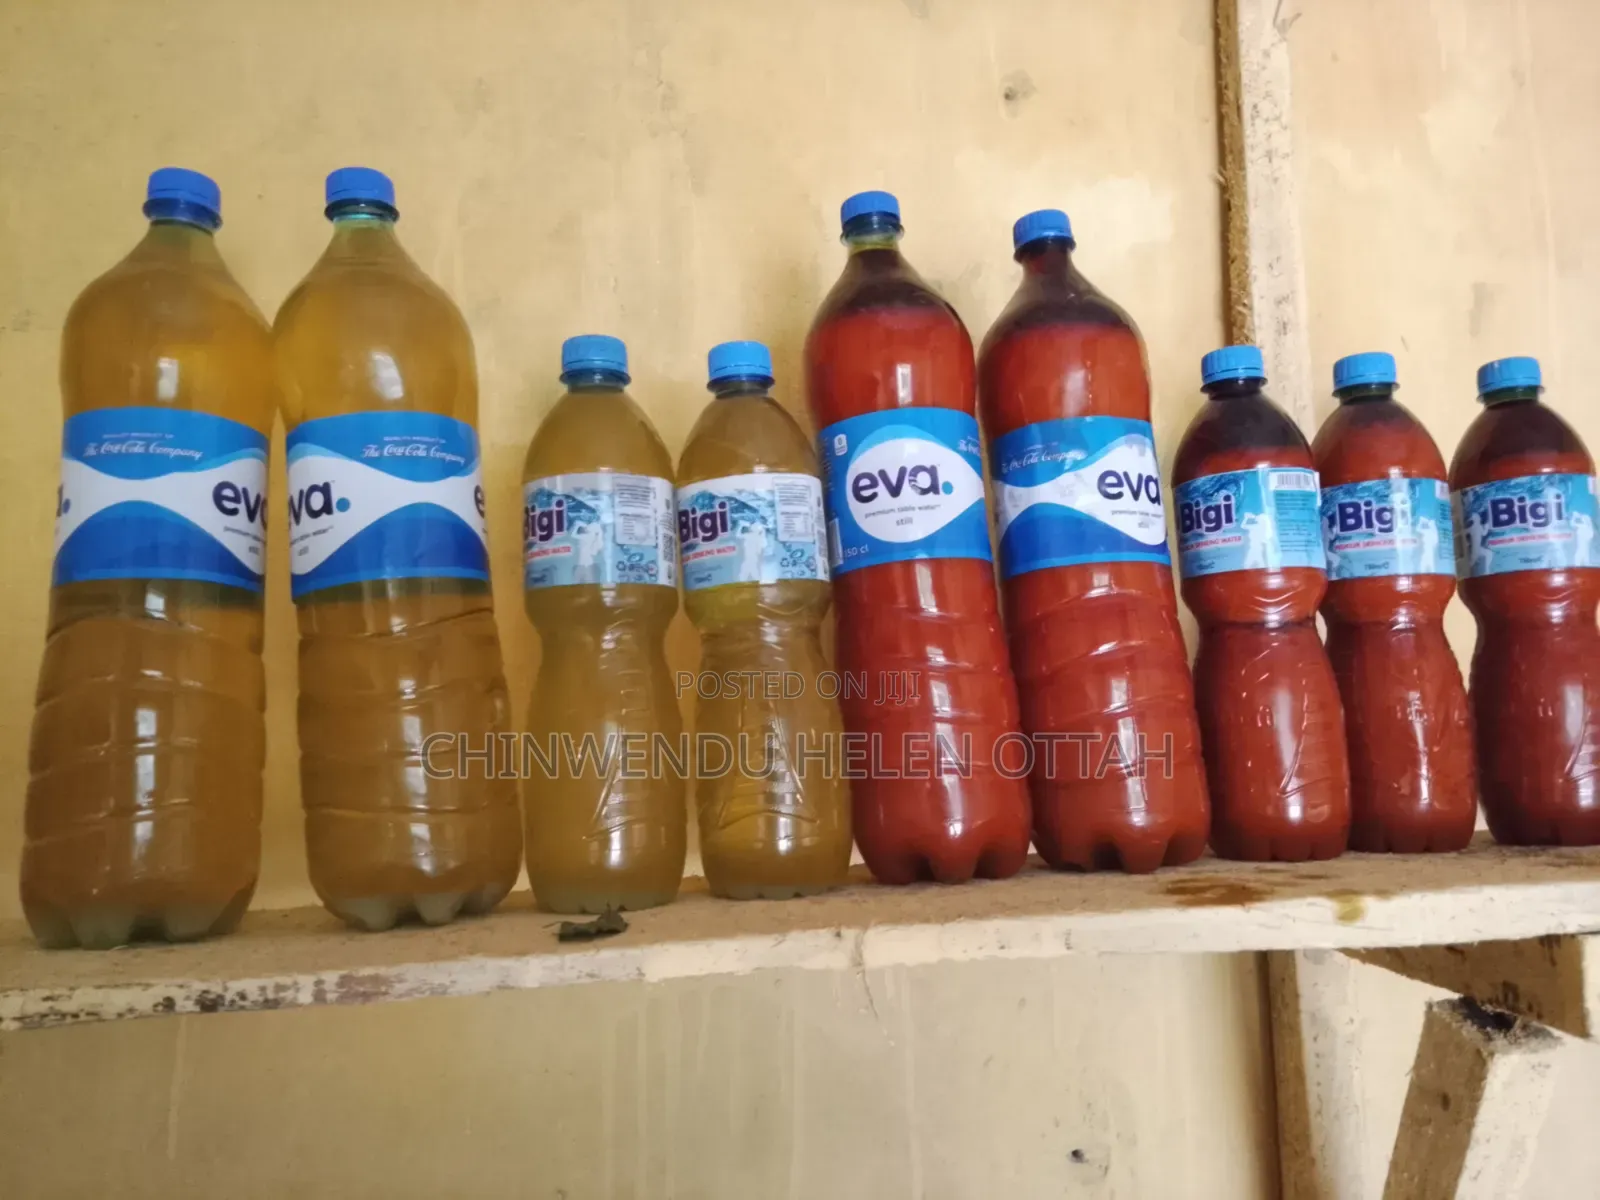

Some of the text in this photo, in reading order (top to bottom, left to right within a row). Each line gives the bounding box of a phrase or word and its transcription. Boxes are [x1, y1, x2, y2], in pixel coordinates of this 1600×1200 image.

[149, 441, 203, 461] Company
[430, 446, 466, 466] Company
[678, 501, 729, 543] Bigi
[1180, 494, 1234, 534] Bigi
[1337, 499, 1409, 533] Bigi
[1490, 493, 1564, 528] Bigi
